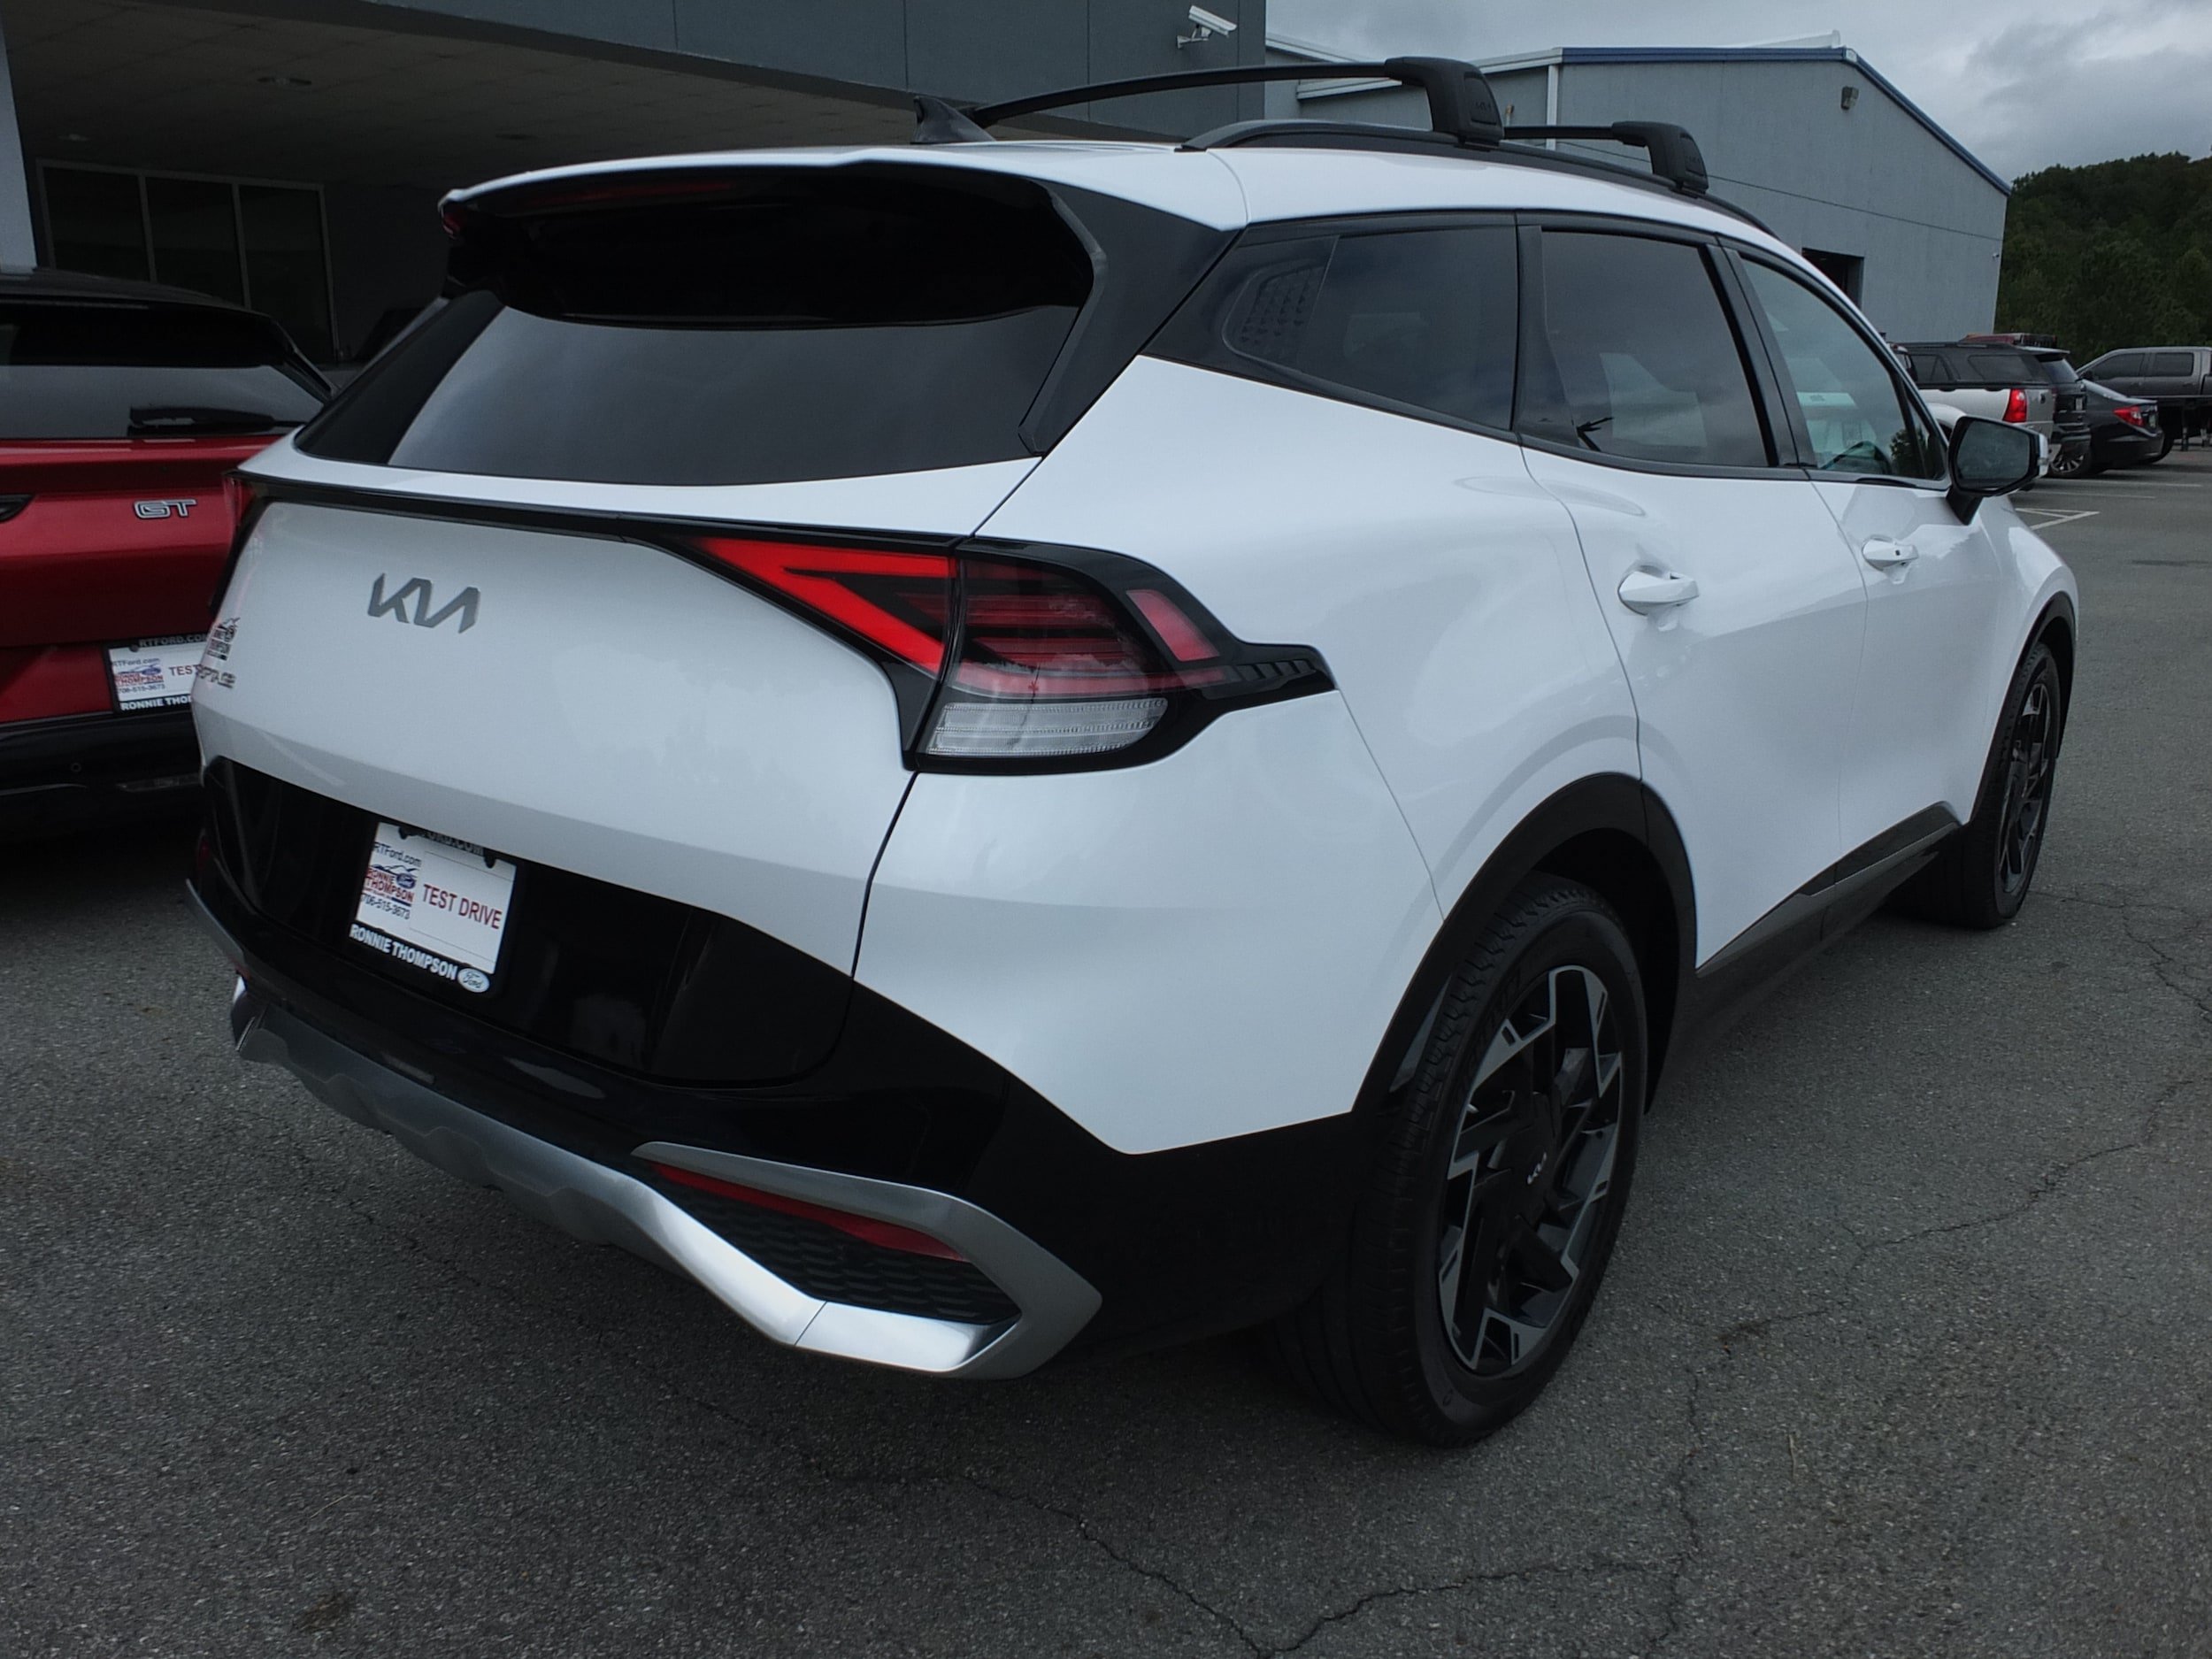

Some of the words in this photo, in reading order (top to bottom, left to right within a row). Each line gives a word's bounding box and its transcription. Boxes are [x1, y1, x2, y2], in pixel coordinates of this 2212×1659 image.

[134, 498, 197, 519] GT
[367, 572, 481, 634] KIA
[120, 699, 165, 710] RONNIE
[423, 884, 457, 912] TEST
[458, 898, 503, 929] DRIVE
[349, 923, 392, 953] RONNIE
[391, 941, 458, 980] THOMPSON
[462, 972, 484, 989] Ford
